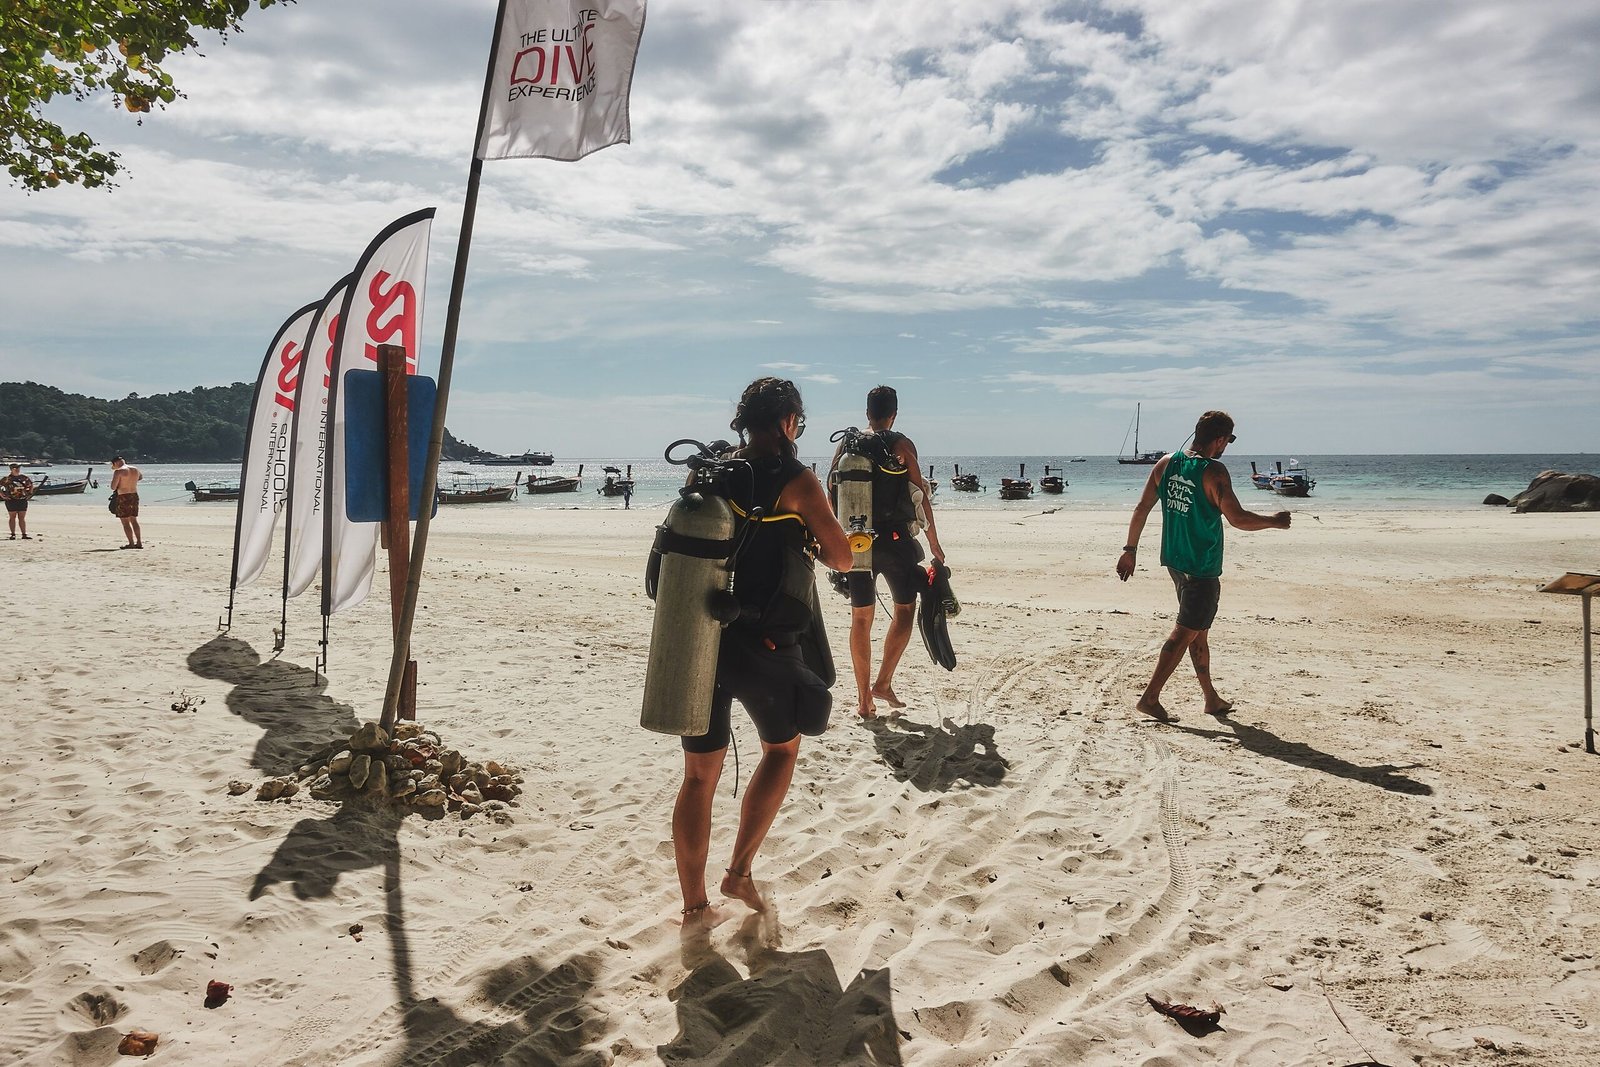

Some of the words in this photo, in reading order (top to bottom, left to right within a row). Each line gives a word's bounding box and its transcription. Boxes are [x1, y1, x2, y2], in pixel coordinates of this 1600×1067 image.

[520, 29, 547, 48] THE
[551, 9, 598, 42] ULTITE
[510, 23, 595, 86] DIVE
[508, 71, 596, 102] EXPERIENCE
[260, 422, 278, 514] INTERNATIONAL
[313, 410, 328, 516] INTERNATIONAL
[1167, 489, 1193, 503] Vida
